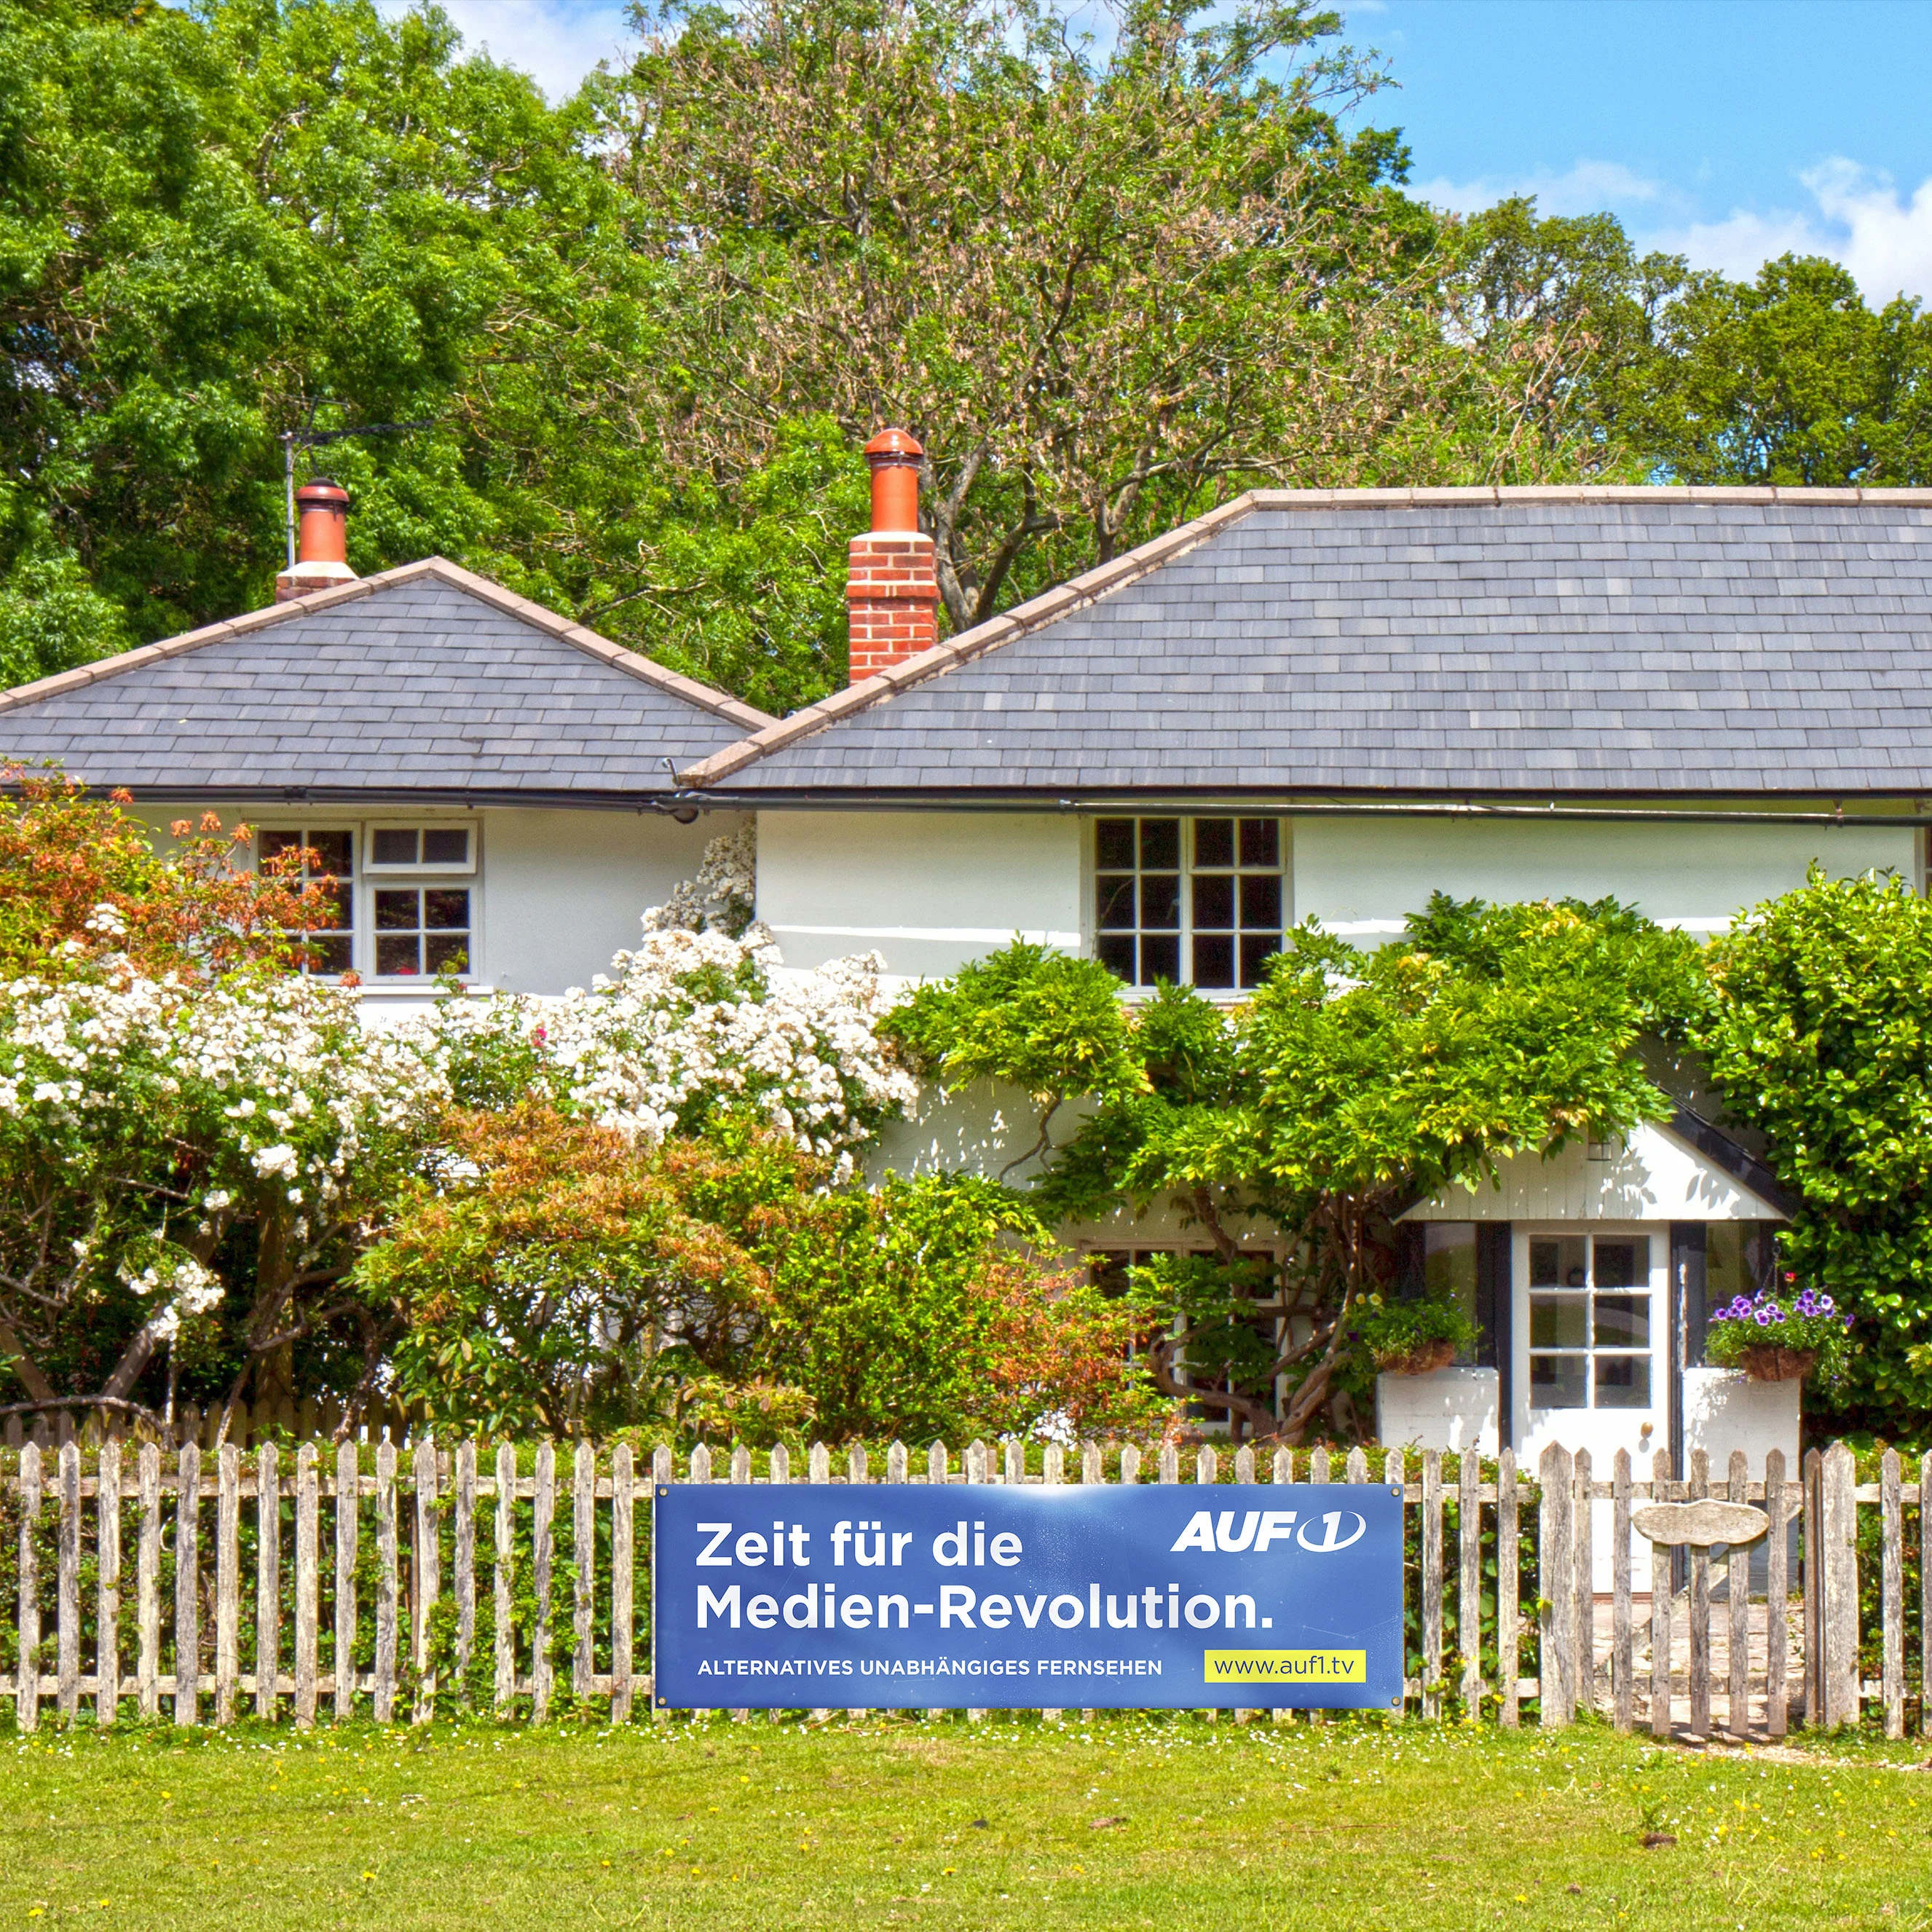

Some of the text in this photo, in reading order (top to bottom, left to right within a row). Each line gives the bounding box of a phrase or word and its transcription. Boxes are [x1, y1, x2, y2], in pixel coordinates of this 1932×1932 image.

[696, 1521, 1023, 1566] Zeit für die
[698, 1583, 1273, 1628] Medien-Revolution.
[698, 1657, 1161, 1675] ALTERNATIVES UNABHÄNGIGES FERNSEHEN
[1215, 1655, 1355, 1674] www.auf1.tv
